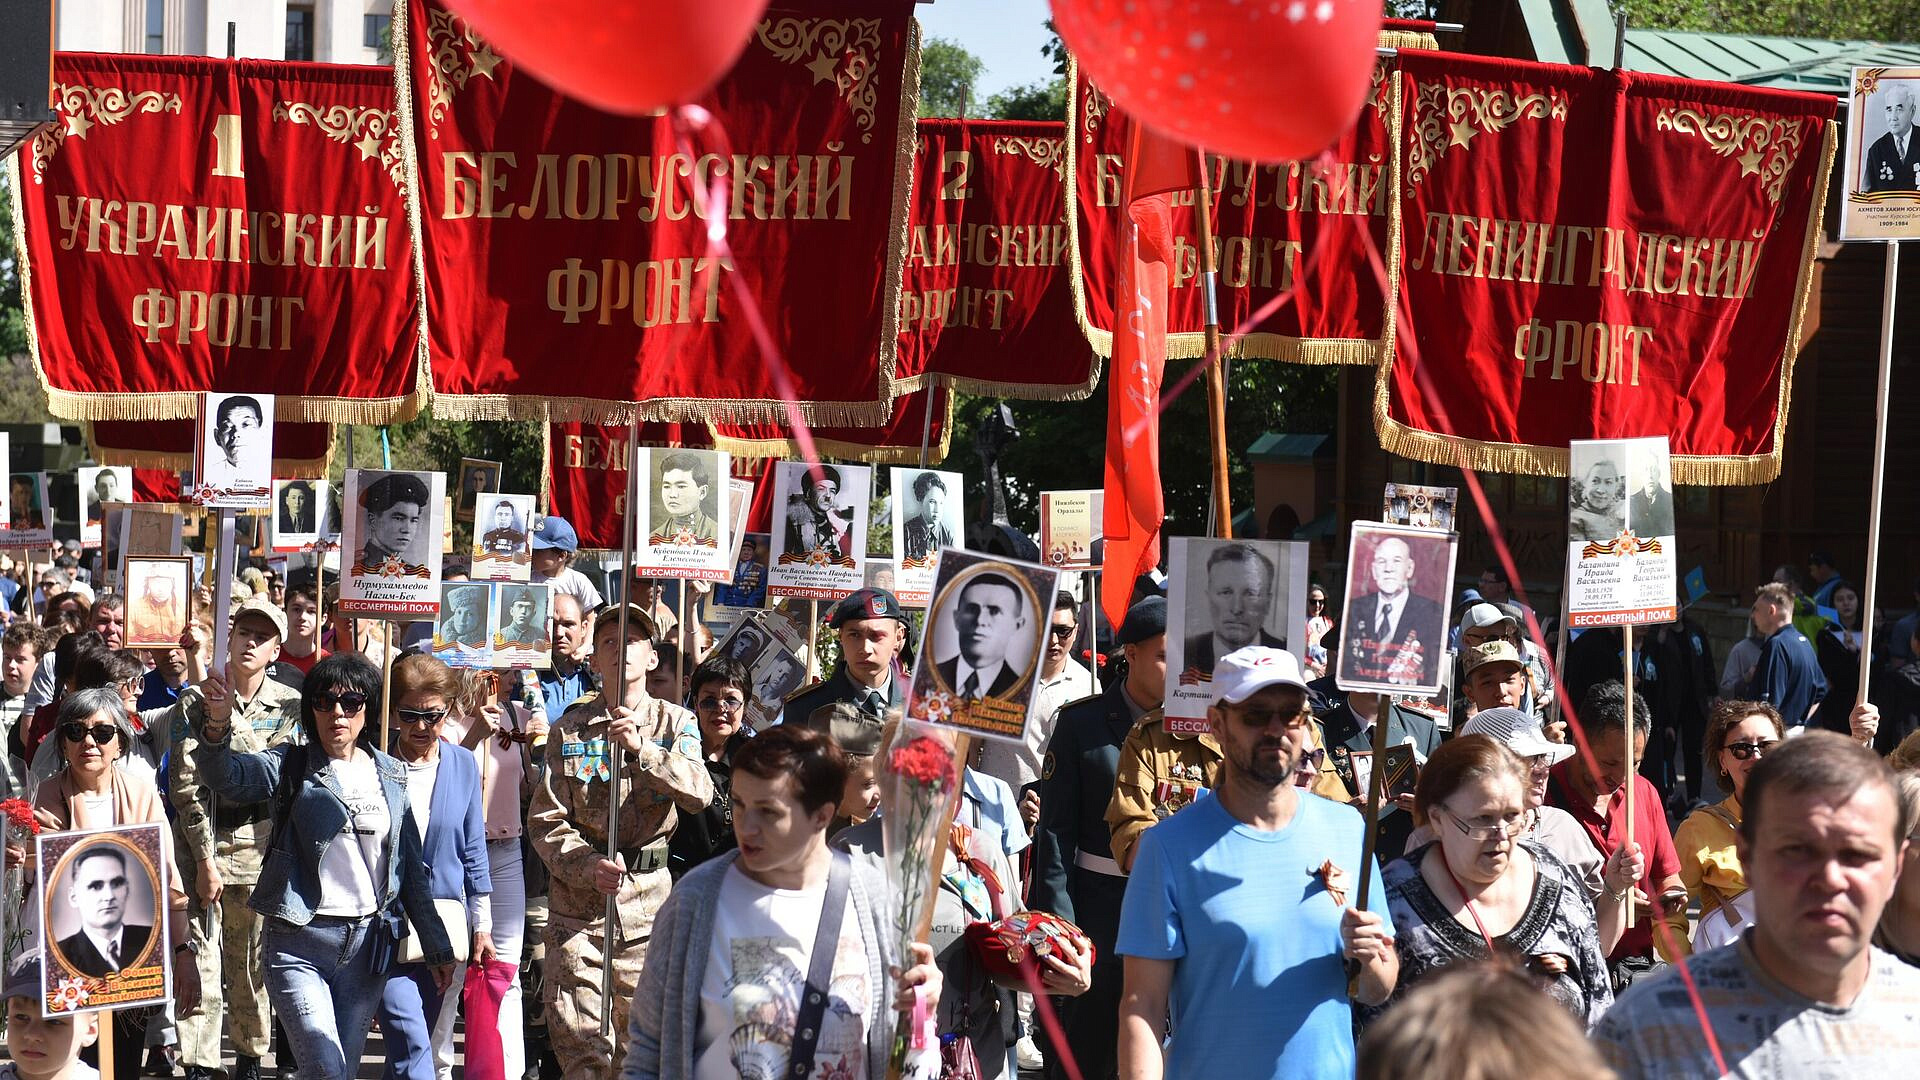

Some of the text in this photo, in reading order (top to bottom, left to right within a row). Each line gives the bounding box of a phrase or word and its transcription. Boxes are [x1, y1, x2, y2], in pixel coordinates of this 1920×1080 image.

[212, 114, 245, 178] 1
[442, 140, 855, 221] БЕЛОРУССКИЙ
[941, 151, 974, 200] 2
[55, 195, 389, 271] УКРАИНСКИЙ
[1413, 212, 1766, 299] ЛЕНИНГРАДСКИЙ
[547, 257, 734, 328] ФРОНТ
[132, 288, 305, 351] ФРОНТ
[1515, 317, 1655, 387] ФРОНТ
[1577, 560, 1620, 569] Баландина
[642, 568, 725, 579] БЕССМЕРТНЫЙ ПОЛК
[790, 567, 827, 575] Васильевич
[829, 569, 862, 577] Панфилов
[1584, 568, 1614, 578] Ираида
[353, 579, 428, 590] Нурмухаммедов
[1576, 577, 1621, 585] Васильевна
[364, 590, 416, 601] Нагим-Бек
[772, 588, 831, 598] БЕССМЕРТНЫЙ
[344, 602, 434, 612] БЕССМЕРТНЫЙ ПОЛК
[1575, 609, 1671, 625] БЕССМЕРТНЫЙ ПОЛК
[122, 967, 162, 978] Фомин
[111, 976, 162, 990] Василий
[90, 989, 162, 1004] Михайлович
